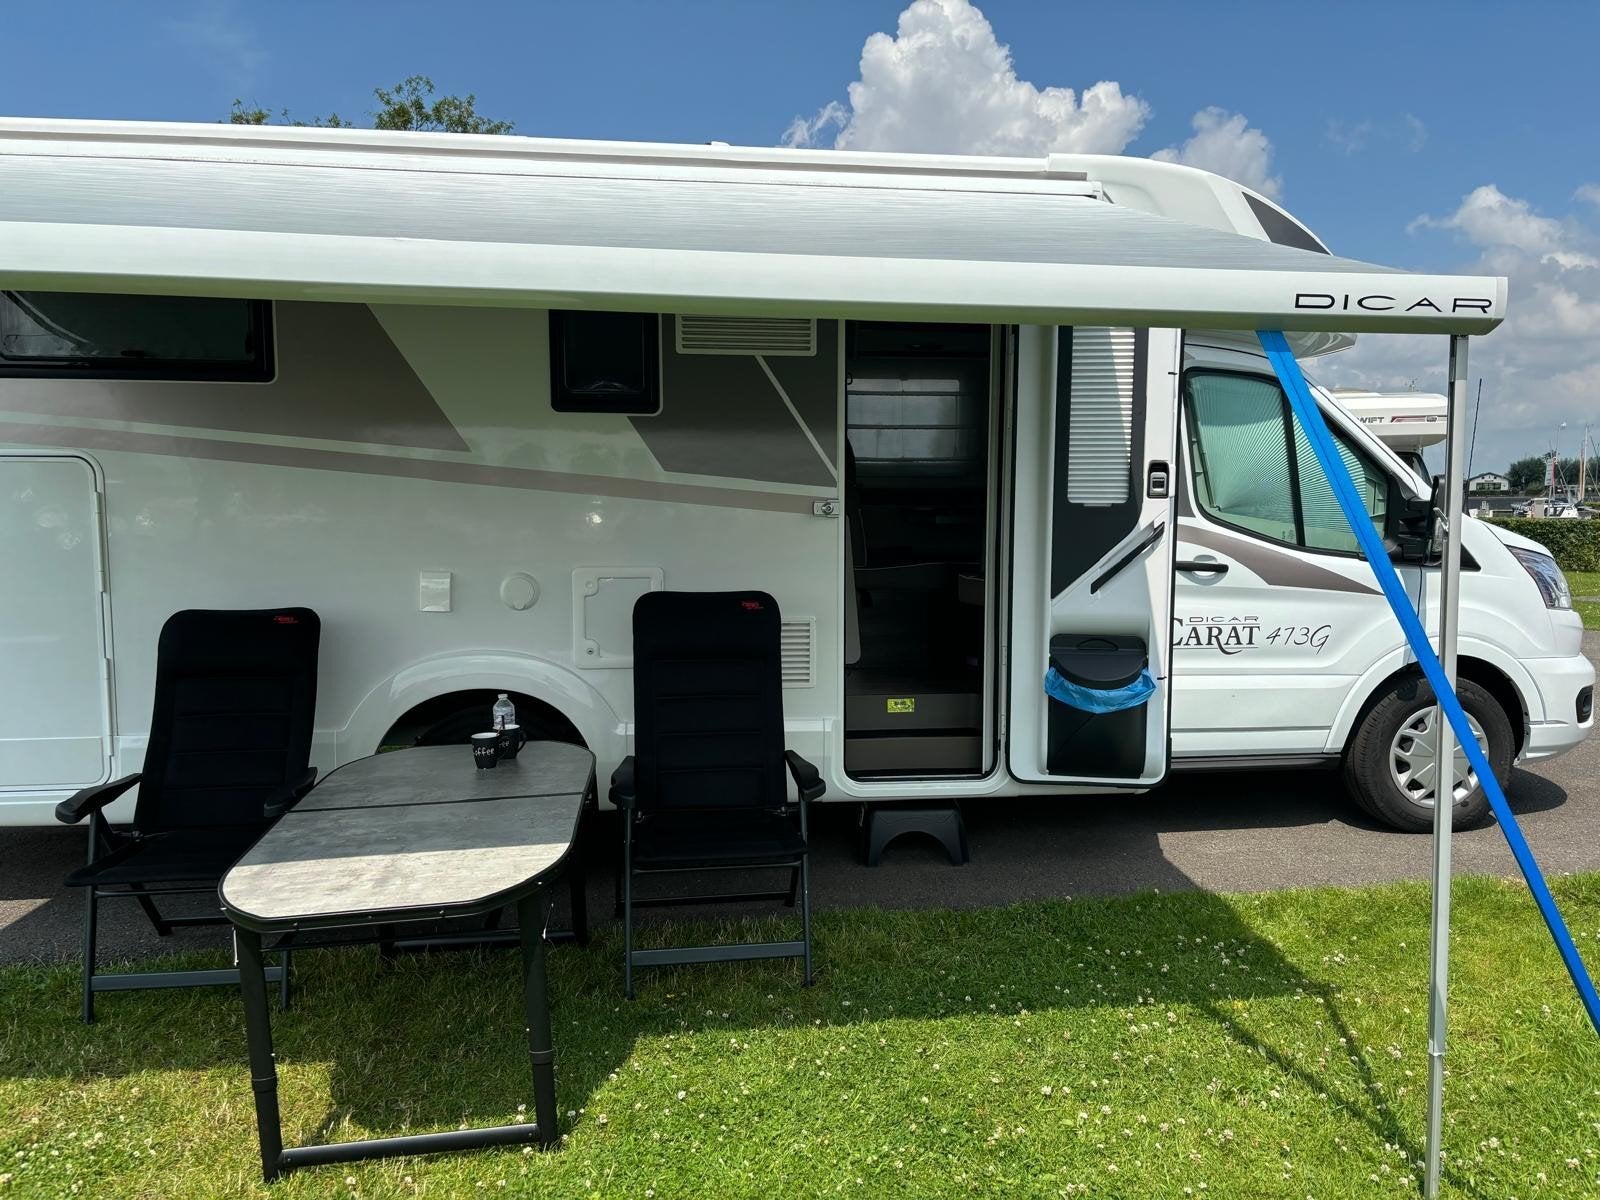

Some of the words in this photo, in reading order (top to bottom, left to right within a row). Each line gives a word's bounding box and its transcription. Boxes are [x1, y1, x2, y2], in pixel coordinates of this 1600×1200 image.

[1294, 293, 1493, 314] DICAR
[1356, 415, 1385, 424] WIFT
[1265, 624, 1332, 655] 473G
